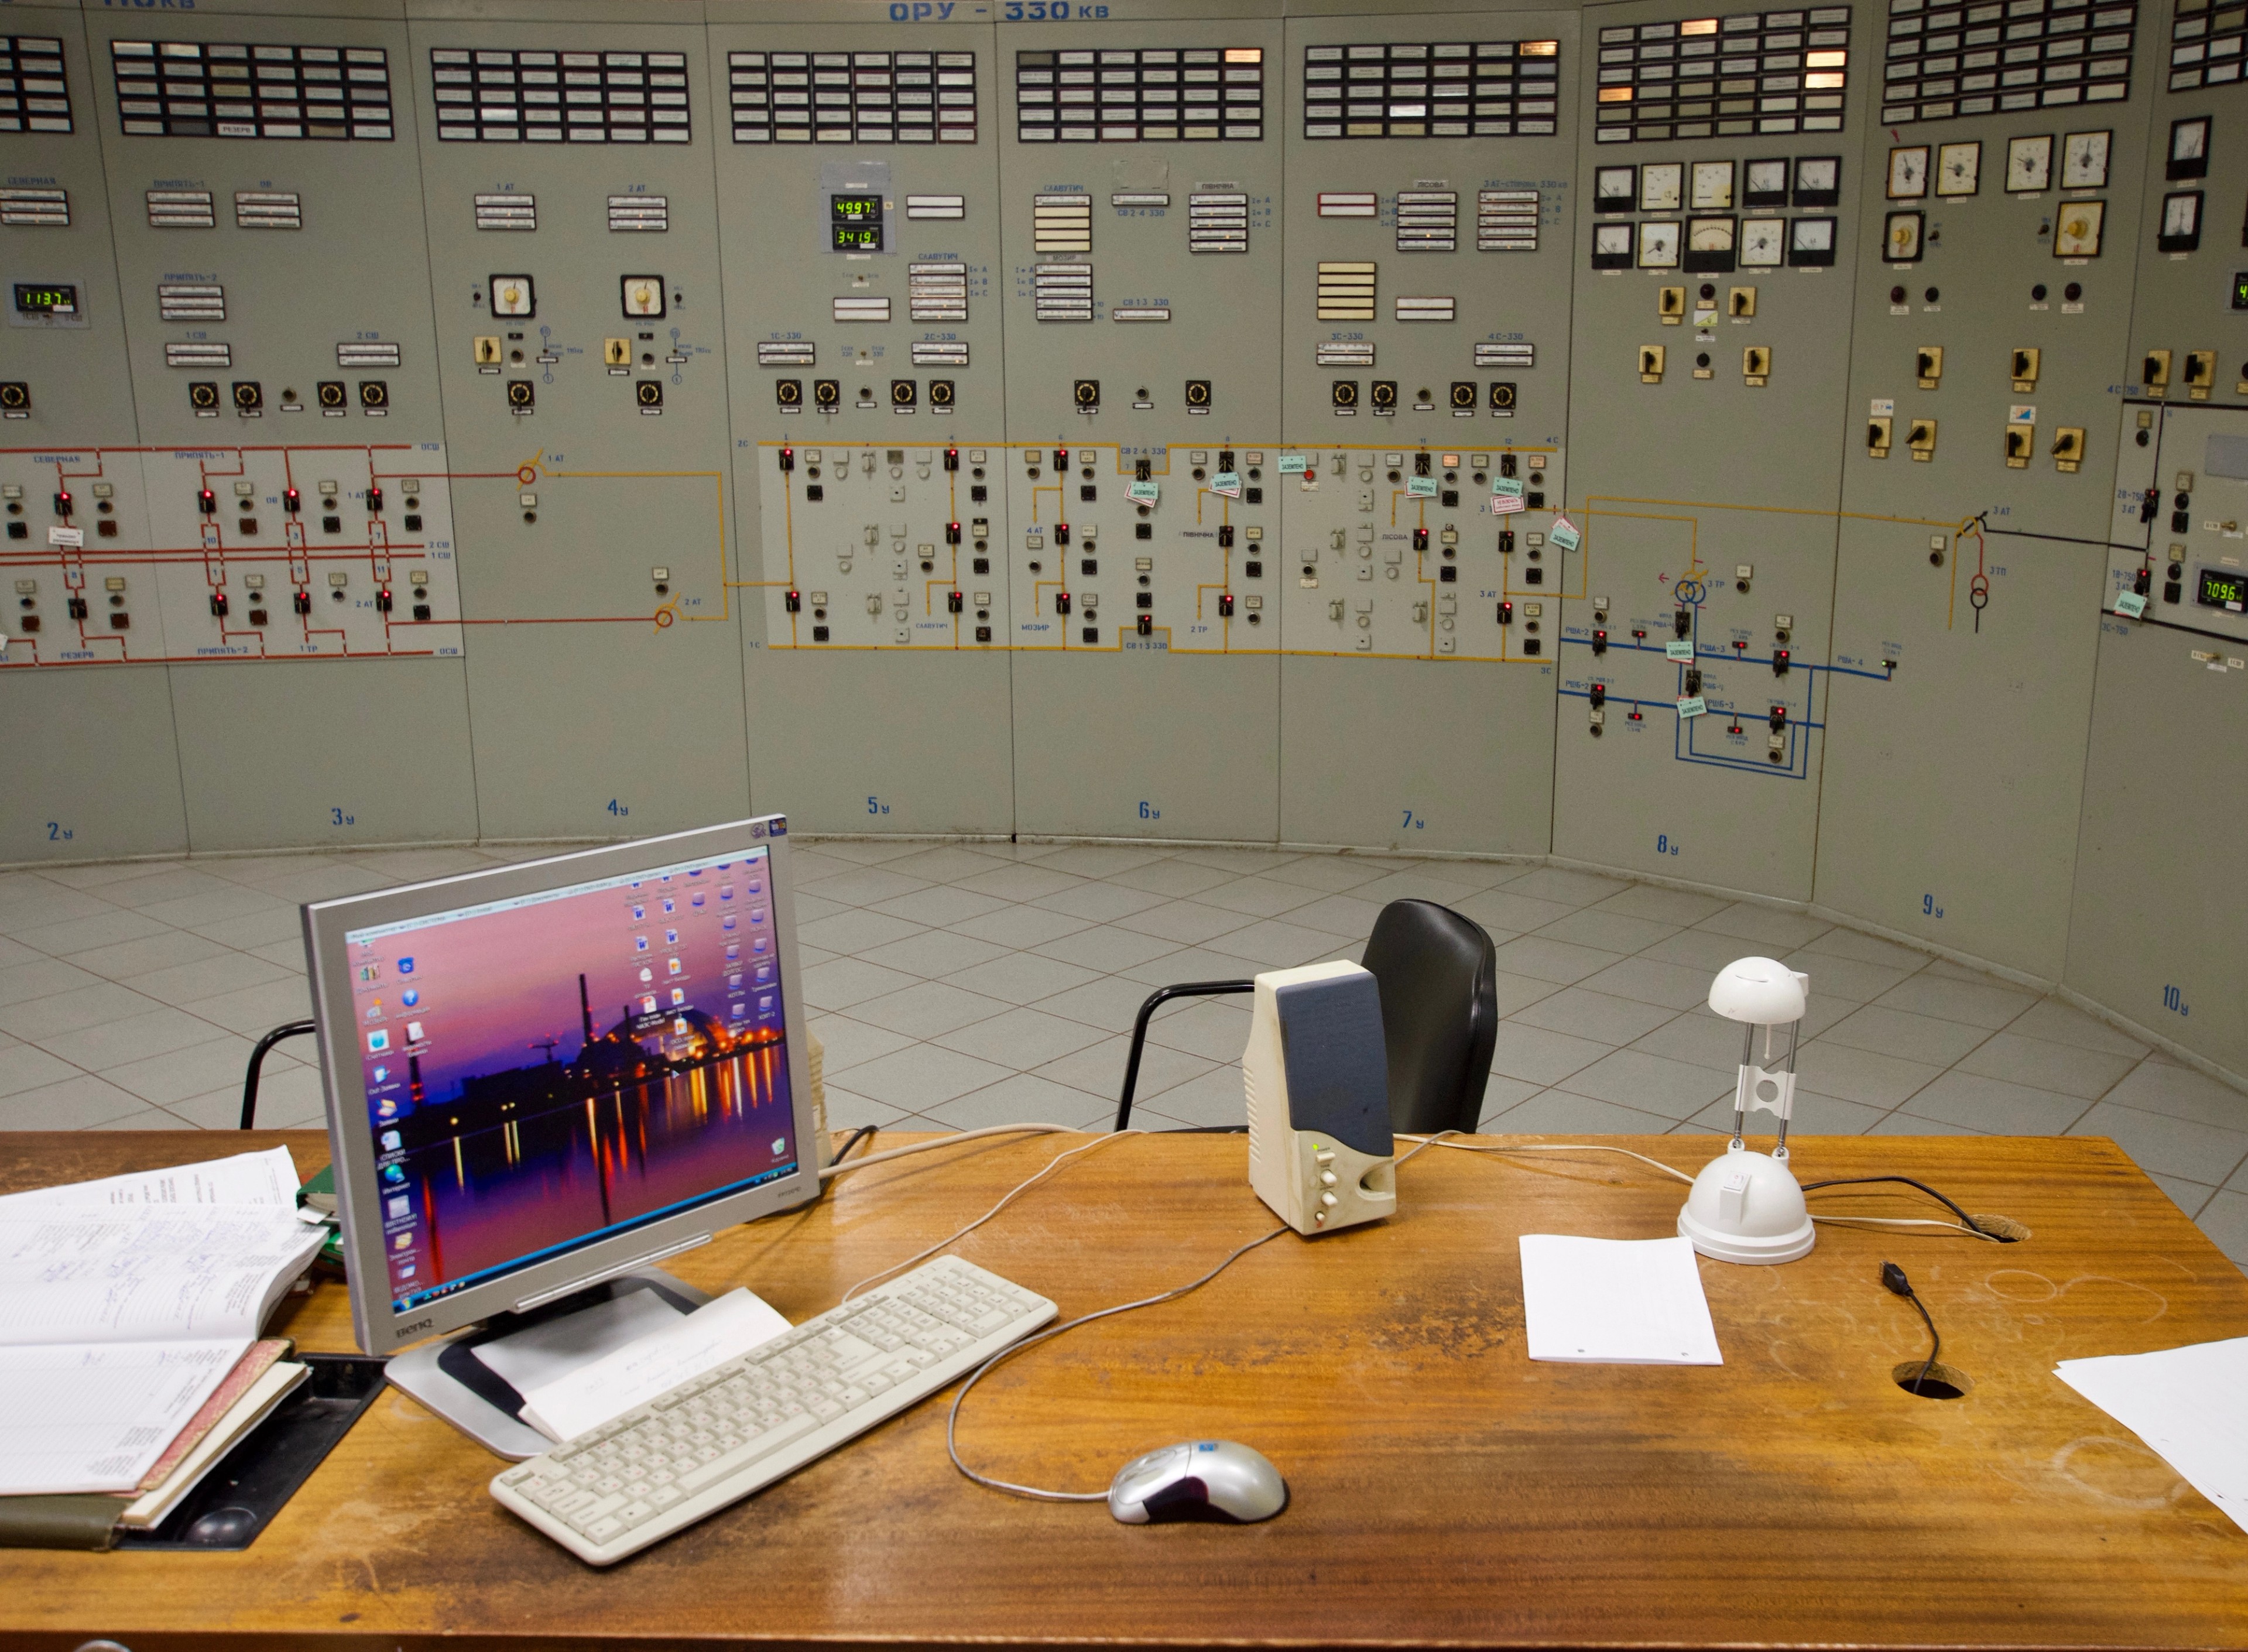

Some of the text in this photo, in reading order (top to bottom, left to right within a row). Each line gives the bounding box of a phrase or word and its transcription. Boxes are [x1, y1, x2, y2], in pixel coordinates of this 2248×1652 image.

[890, 3, 955, 21] ОРУ
[1005, 2, 1070, 21] 330
[838, 232, 871, 244] 341.9
[26, 292, 61, 305] 113.7
[175, 451, 225, 460] ПРИПЯТЬ-1
[1993, 506, 2010, 516] 3 АТ
[1022, 624, 1050, 632] МОЗИР
[1565, 626, 1589, 636] РША-2
[198, 646, 248, 655] ПРИПЯТЬ-2
[1699, 643, 1725, 653] РША-3
[61, 651, 95, 659] РЕЗЕРВ
[1565, 680, 1589, 690] РШБ-2
[1708, 698, 1734, 709] РШБ-3
